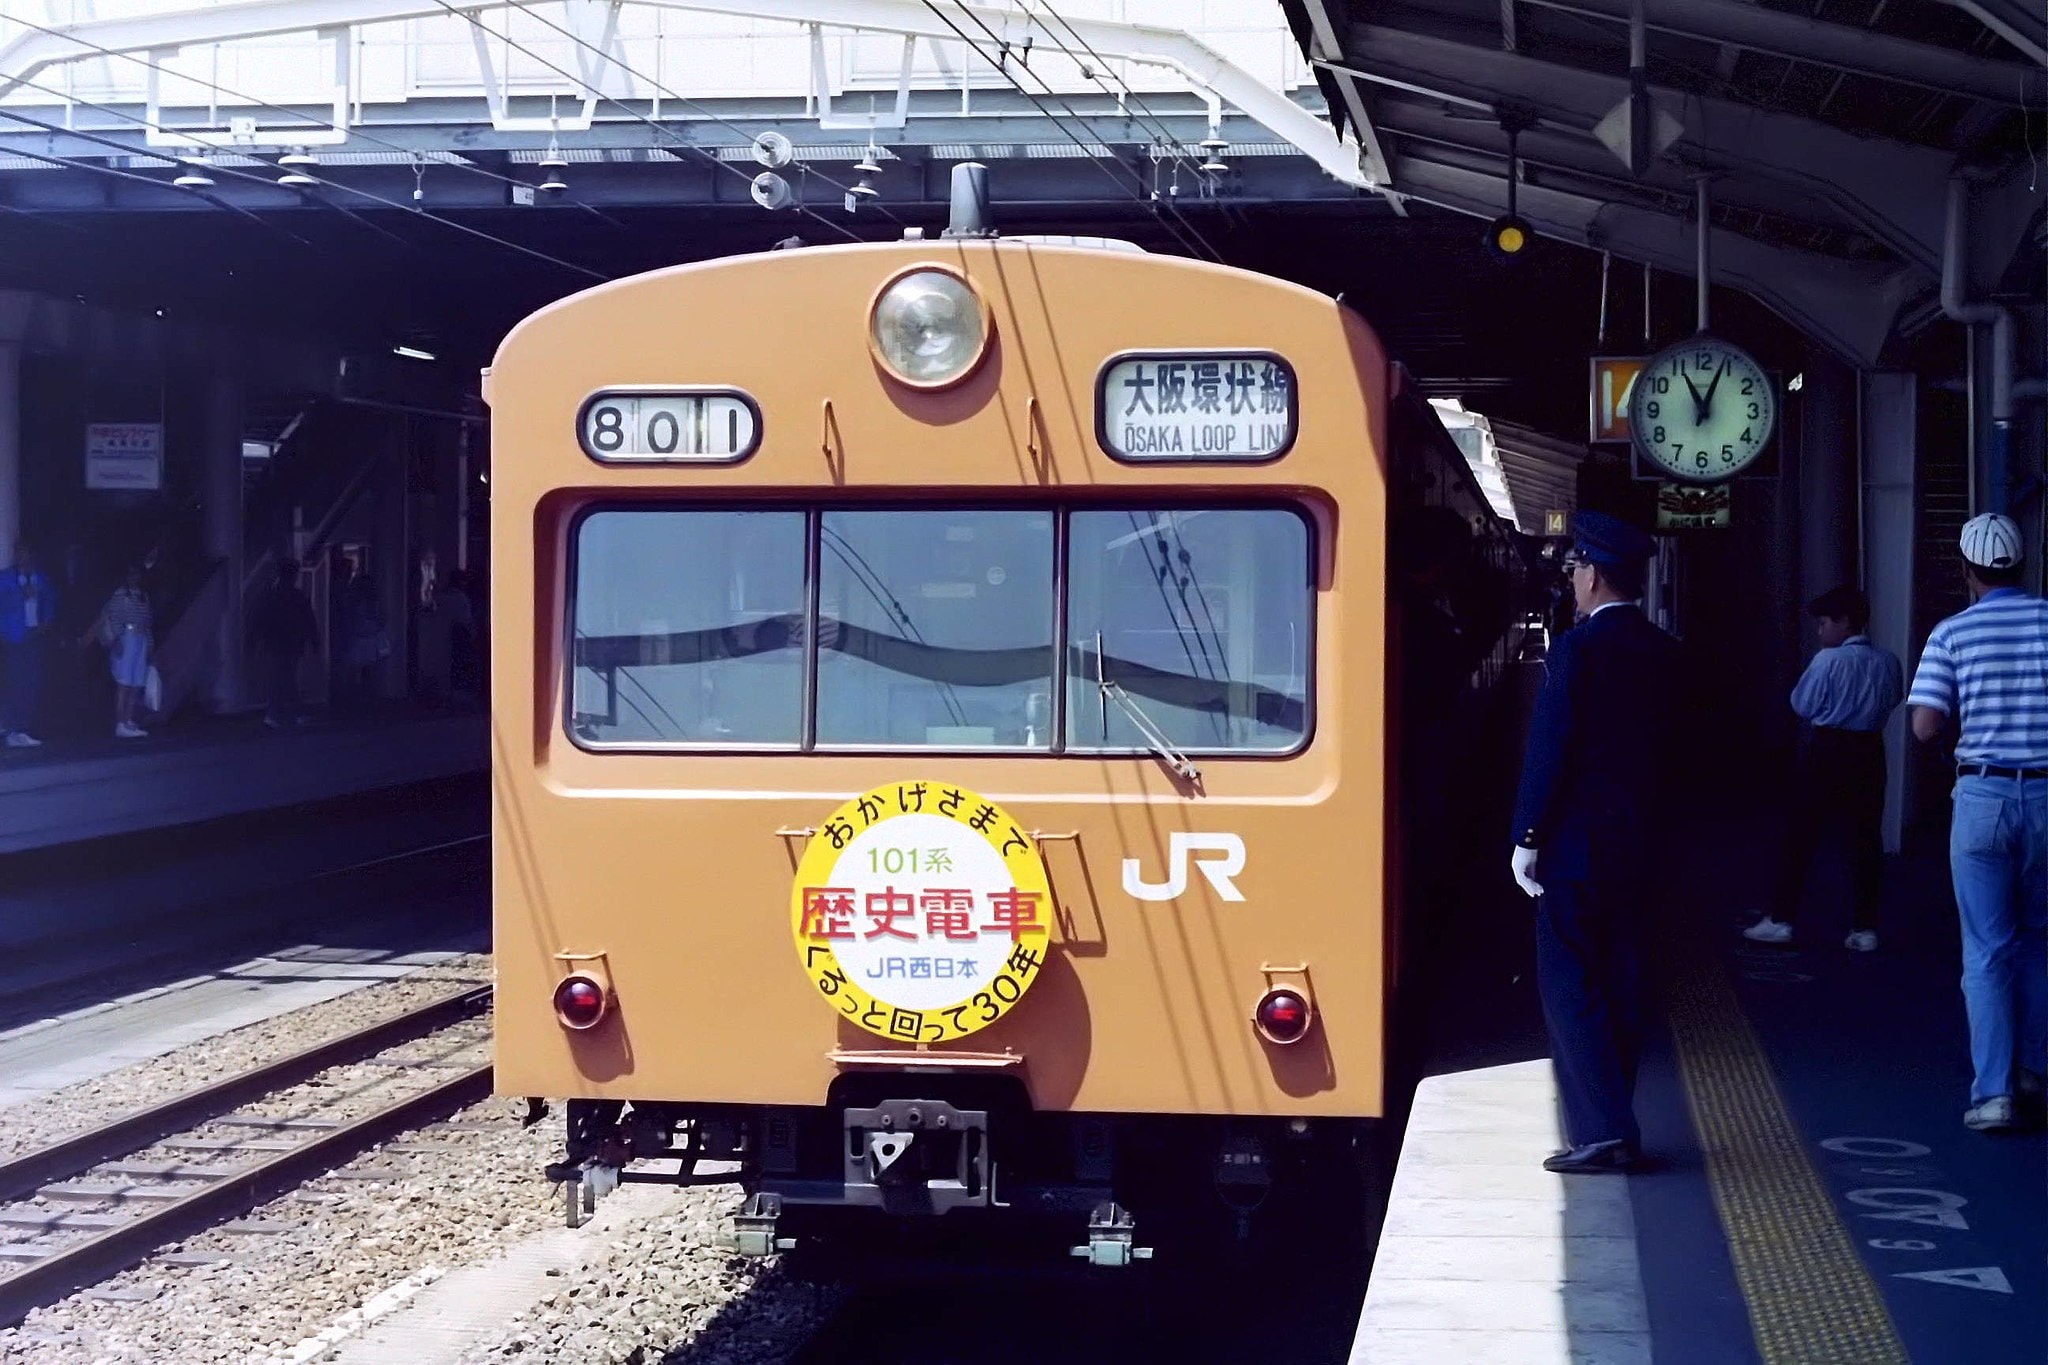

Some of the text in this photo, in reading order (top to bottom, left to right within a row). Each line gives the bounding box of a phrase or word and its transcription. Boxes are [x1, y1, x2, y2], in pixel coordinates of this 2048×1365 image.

[1672, 358, 1686, 376] 11
[1696, 353, 1712, 370] 12
[1124, 363, 1288, 417] 大阪環状線
[1651, 377, 1669, 394] 10
[1741, 378, 1753, 395] 2
[1647, 402, 1660, 419] 9
[1747, 402, 1759, 419] 3
[1191, 424, 1236, 452] LOOP
[1249, 424, 1288, 451] LIN
[1653, 426, 1666, 443] 8
[1740, 427, 1752, 443] 4
[1671, 444, 1684, 461] 7
[1696, 451, 1708, 468] 6
[1721, 445, 1733, 462] 5
[1549, 514, 1562, 531] 14
[824, 782, 1029, 857] おかげさまで
[867, 847, 953, 874] 101系
[1122, 832, 1247, 902] JR
[800, 886, 1046, 942] 歴史電車
[867, 956, 979, 980] JR西日本
